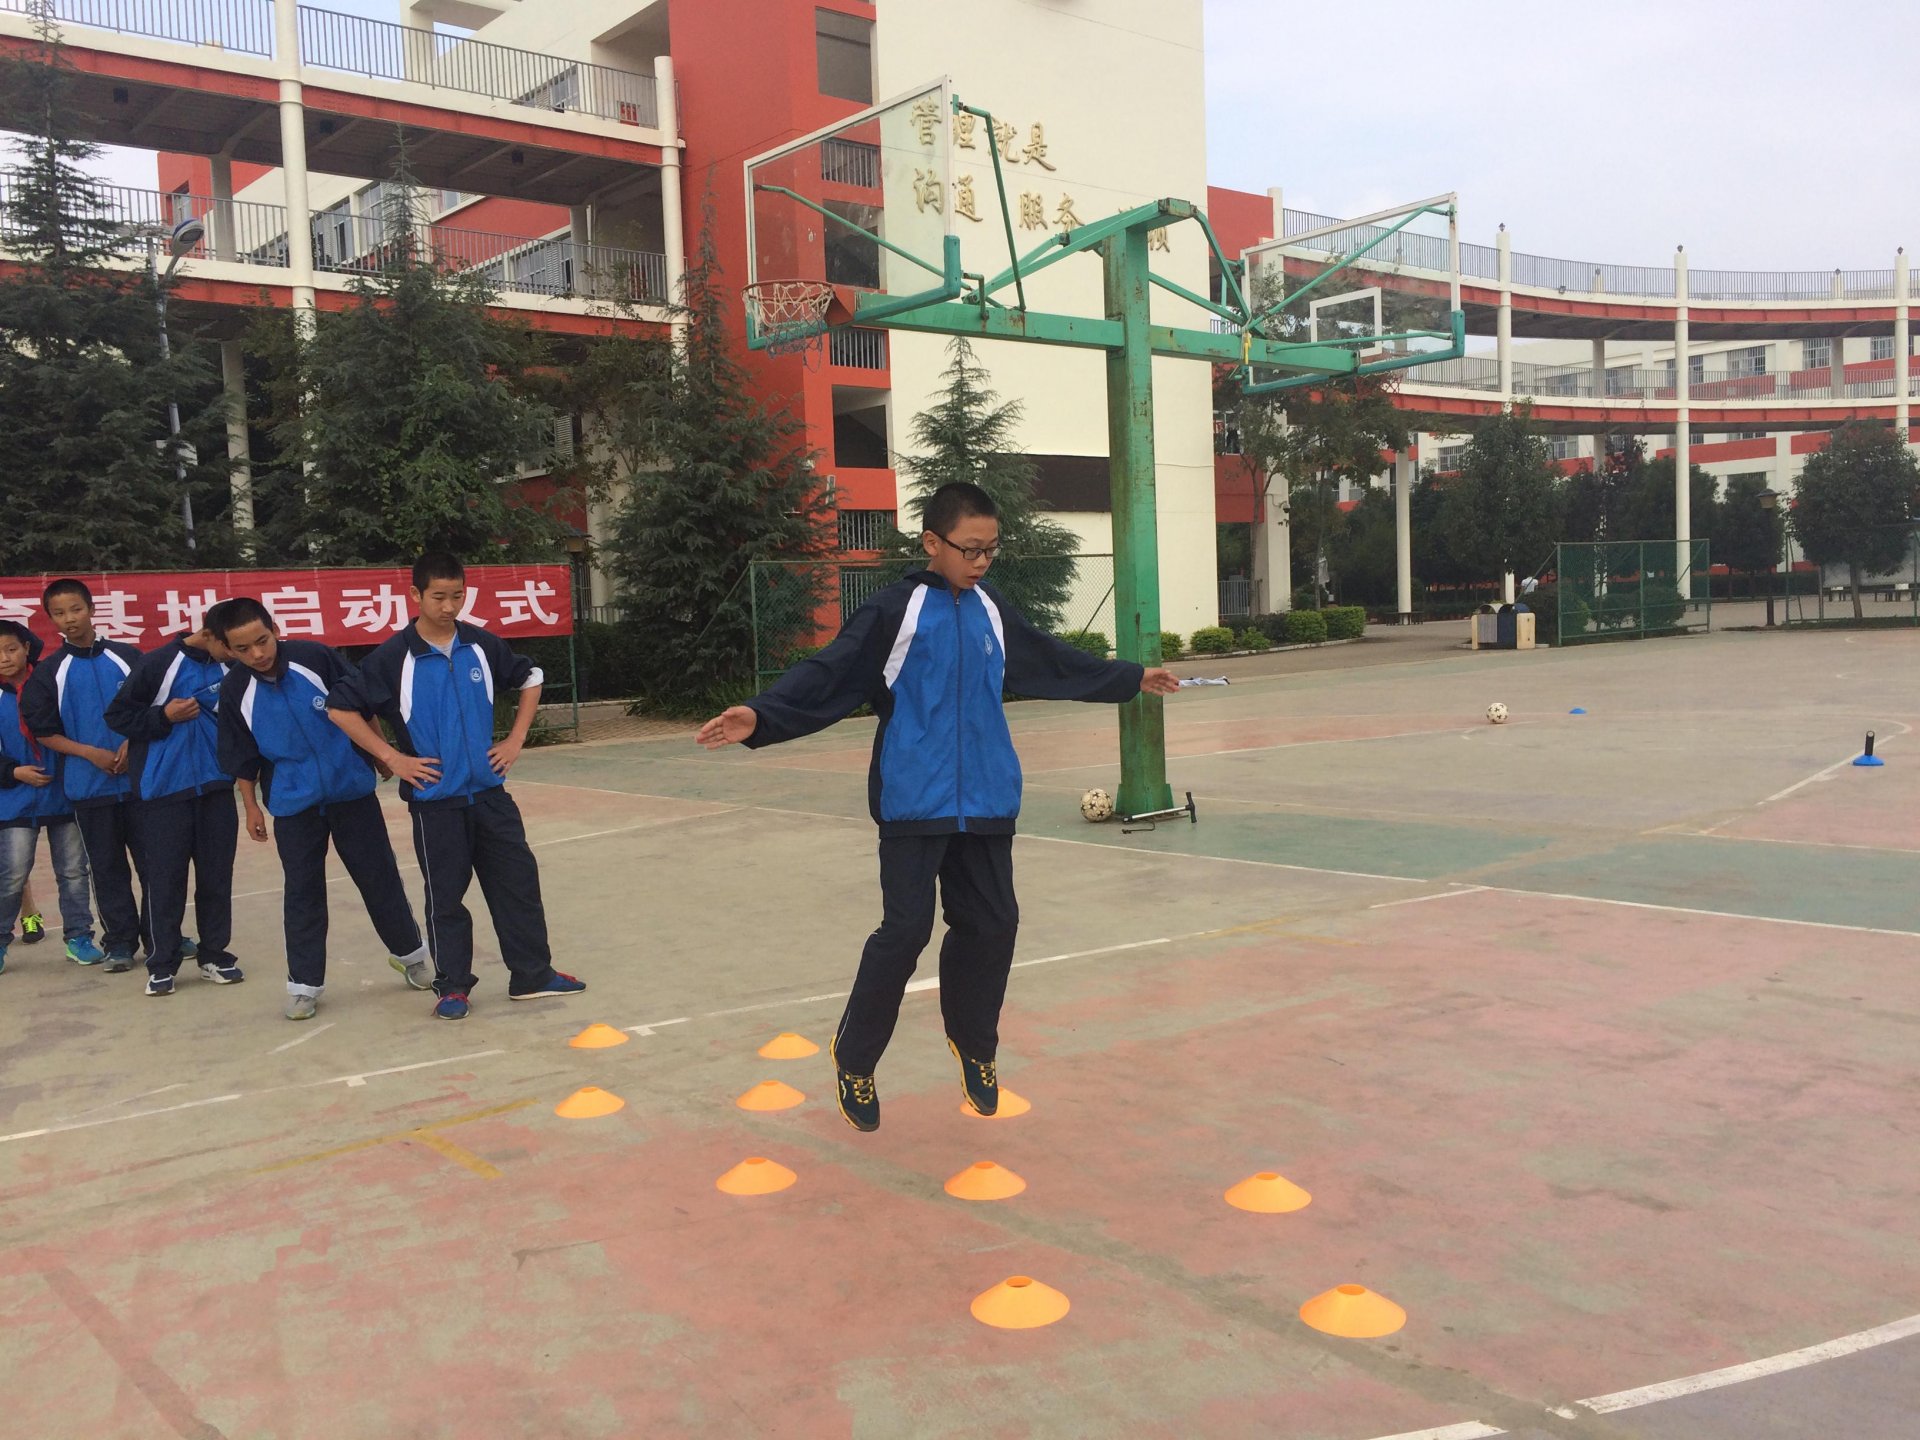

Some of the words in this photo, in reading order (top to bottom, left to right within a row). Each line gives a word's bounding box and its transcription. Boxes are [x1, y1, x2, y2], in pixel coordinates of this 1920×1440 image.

[910, 96, 1057, 172] 管理就是
[913, 168, 983, 222] 沟通
[1019, 191, 1085, 233] 服务
